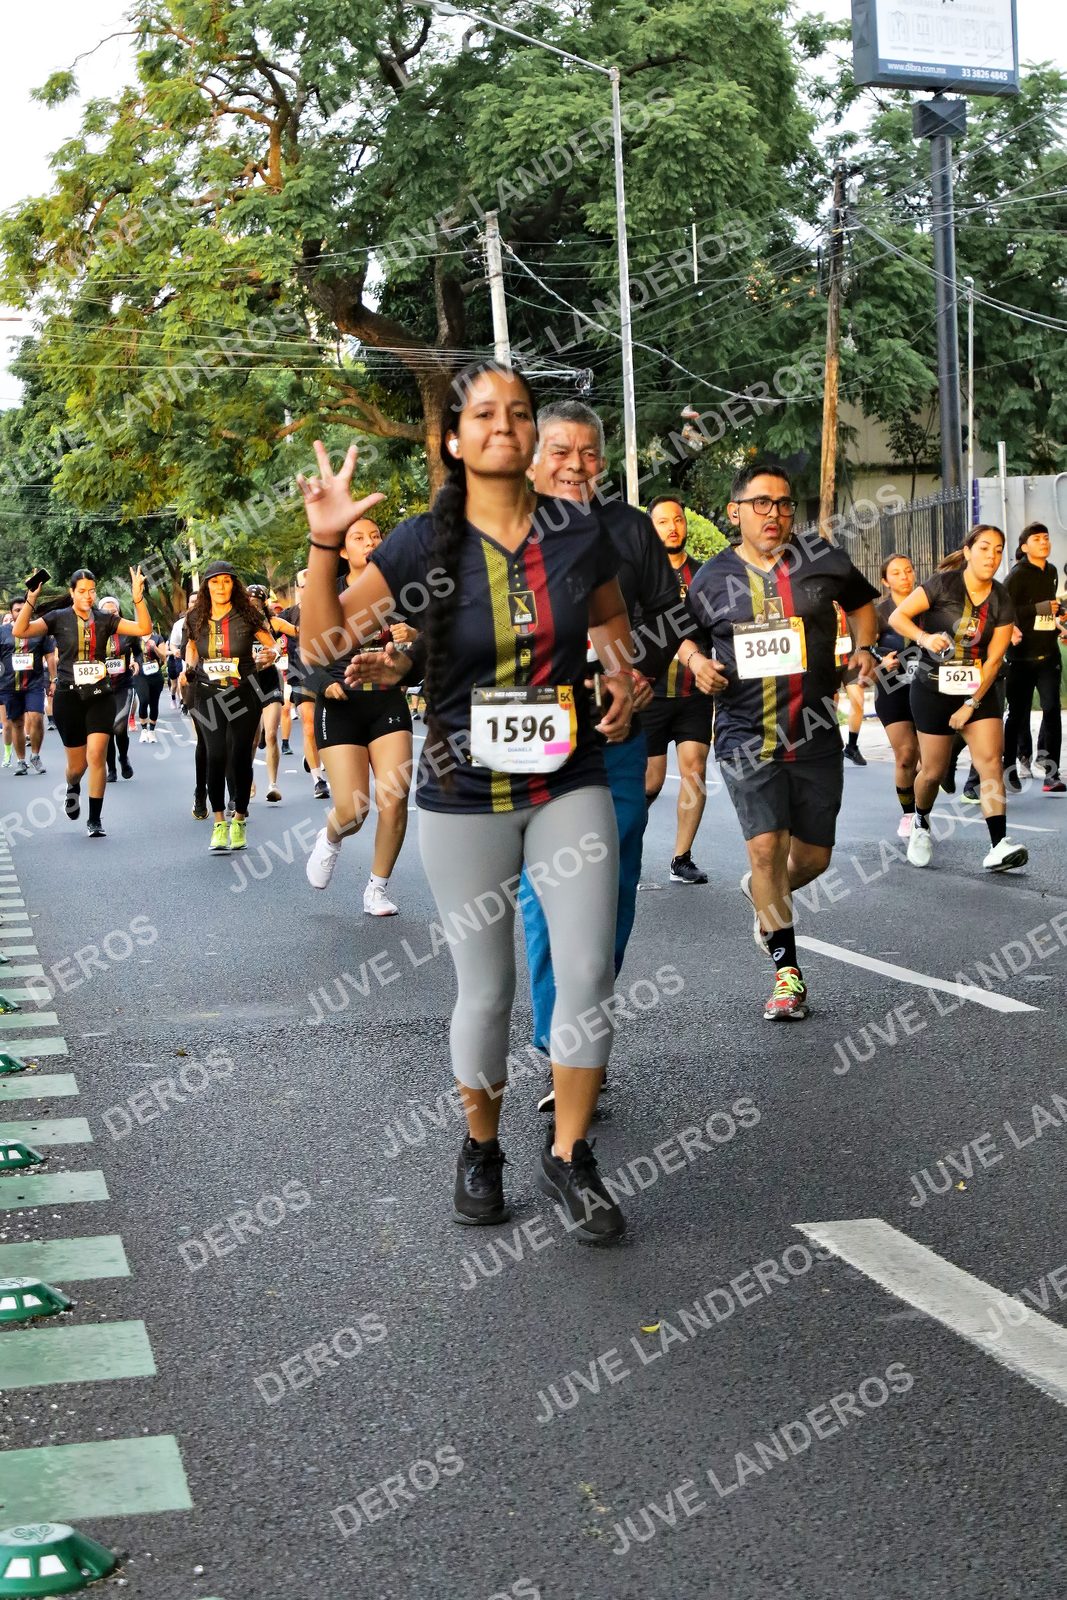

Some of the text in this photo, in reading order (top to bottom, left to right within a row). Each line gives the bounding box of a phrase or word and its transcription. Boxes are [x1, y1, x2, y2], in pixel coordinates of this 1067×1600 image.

[961, 67, 971, 77] 33
[744, 637, 791, 659] 3840
[78, 666, 100, 677] 5825
[945, 670, 974, 682] 5621
[560, 692, 571, 702] 5K
[486, 715, 556, 743] 1596
